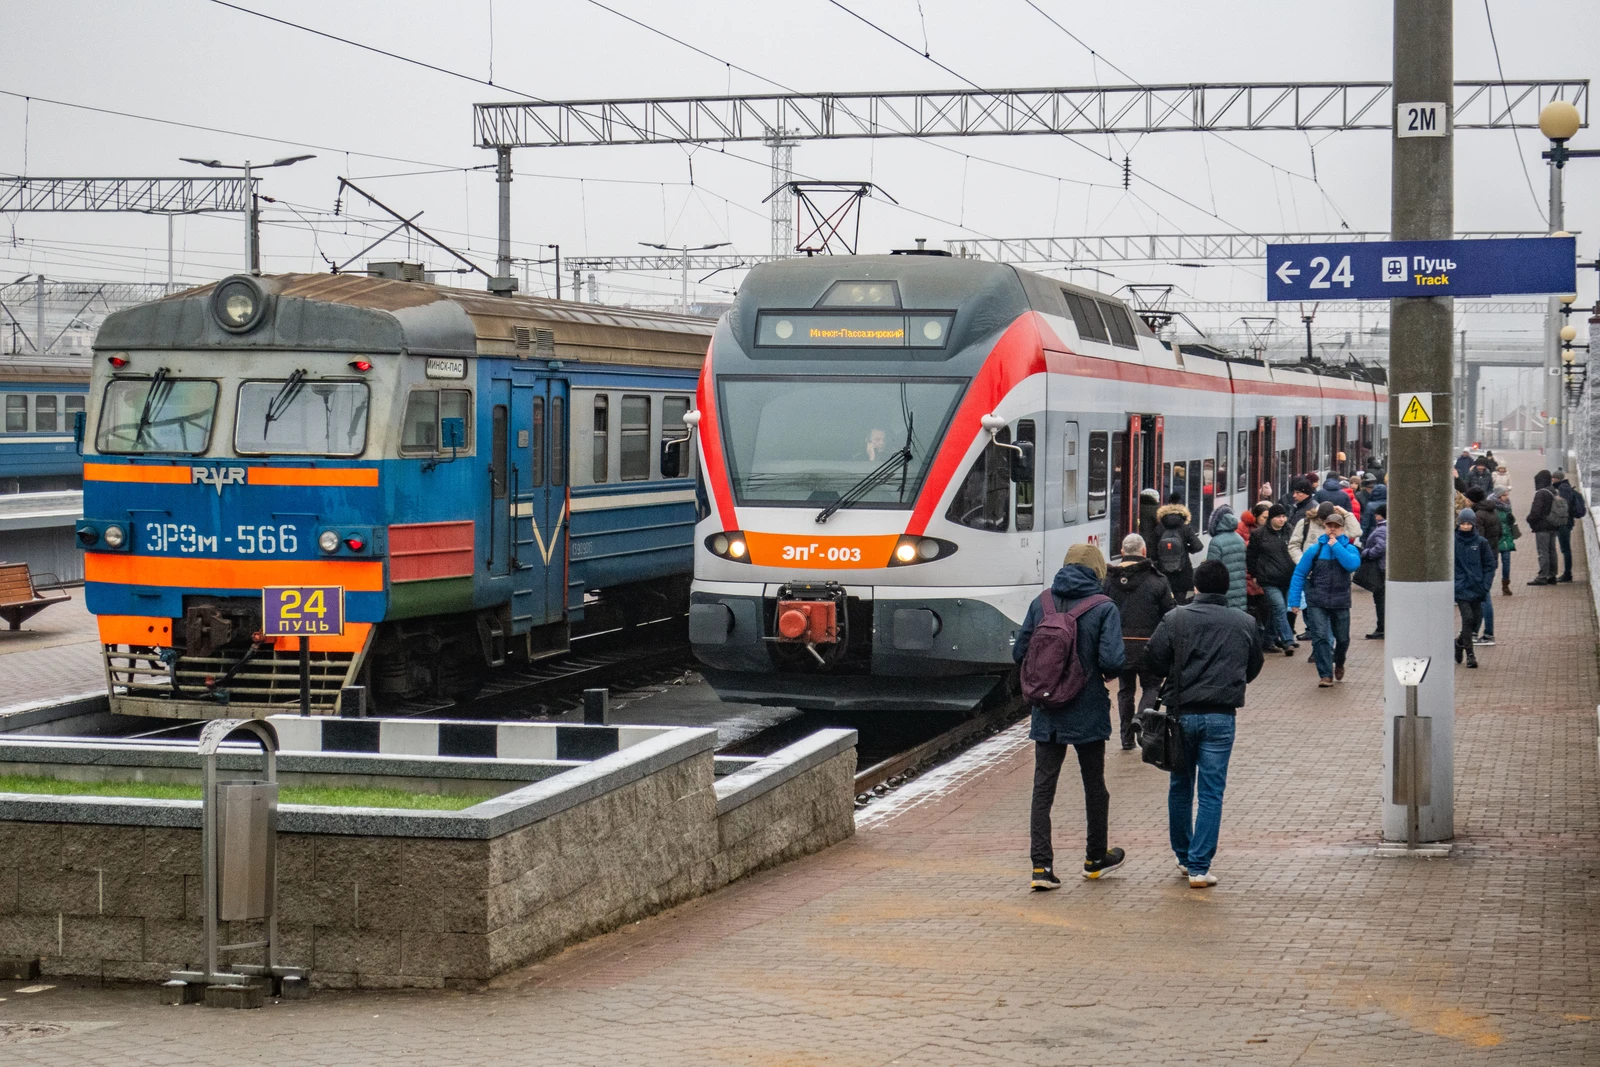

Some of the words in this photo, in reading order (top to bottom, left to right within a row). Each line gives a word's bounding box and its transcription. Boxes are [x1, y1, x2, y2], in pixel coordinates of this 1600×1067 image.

[1309, 255, 1354, 289] 24
[1413, 256, 1457, 273] Пуць
[1414, 274, 1449, 286] Track
[192, 467, 245, 496] RVR
[281, 590, 327, 618] 24
[279, 621, 329, 633] ПУЦЬ
